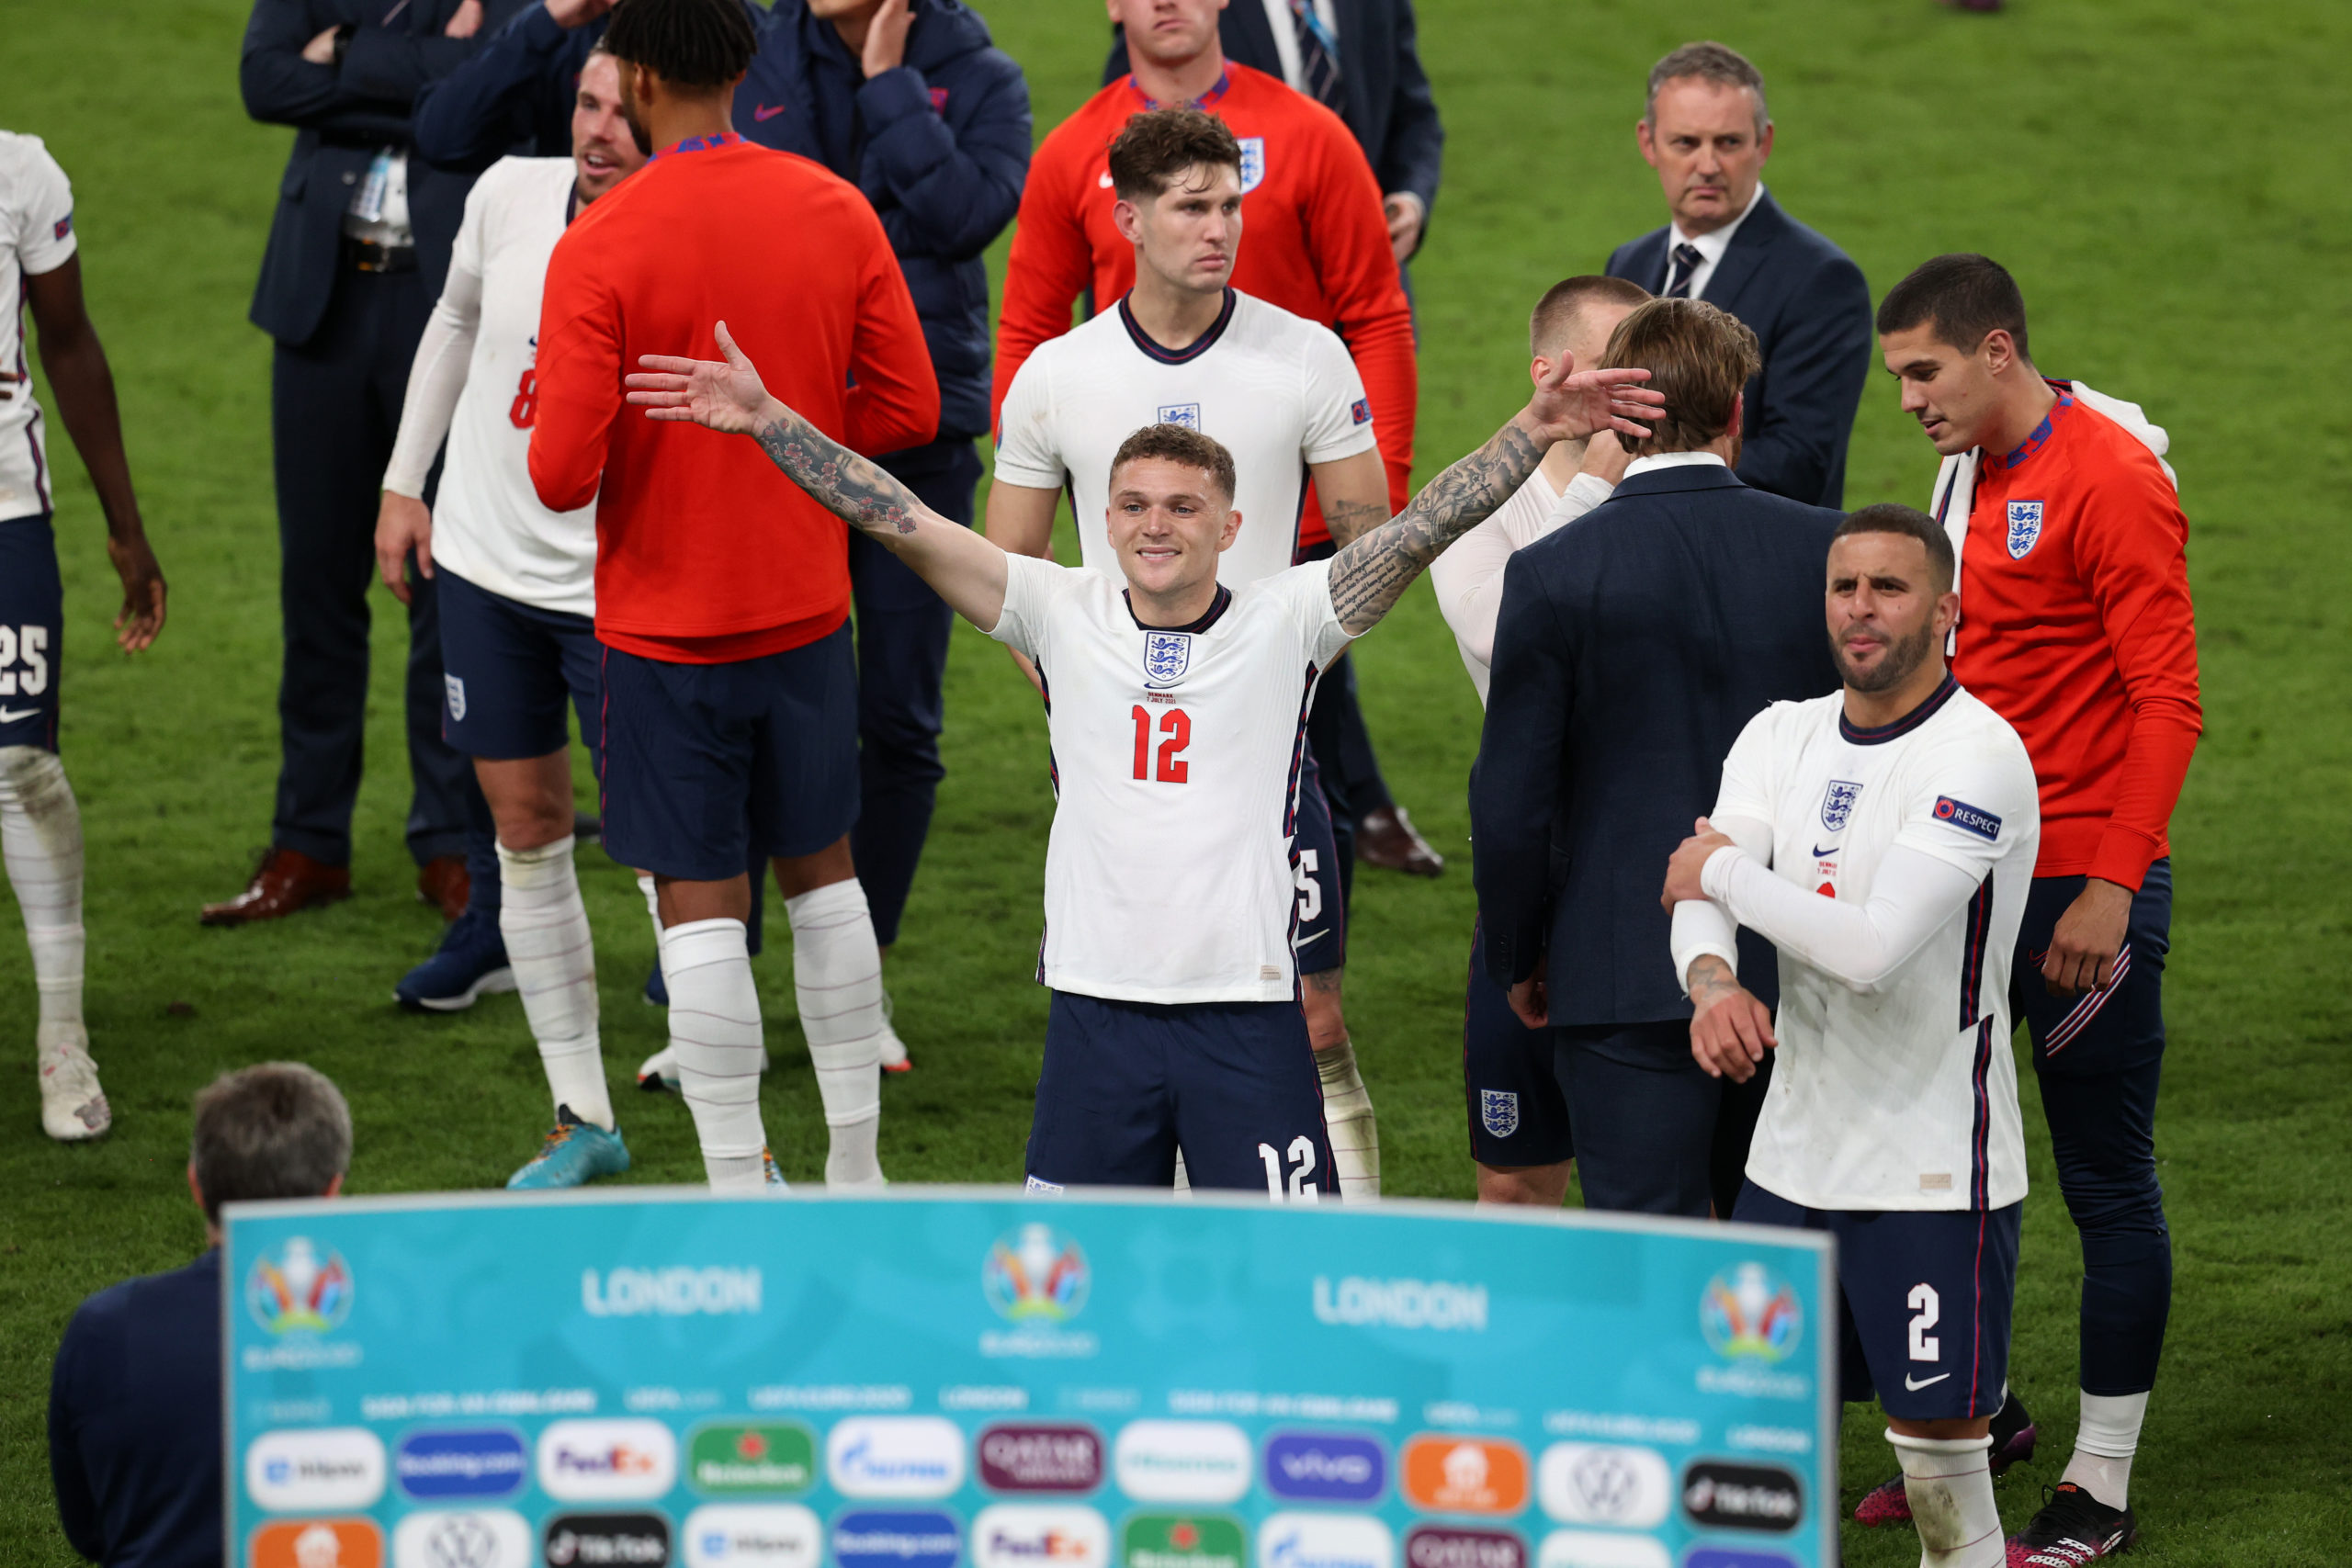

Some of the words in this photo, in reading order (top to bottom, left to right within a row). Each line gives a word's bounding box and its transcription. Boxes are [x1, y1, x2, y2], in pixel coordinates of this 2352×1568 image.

[509, 368, 538, 429] 8
[0, 625, 47, 695] 25
[1132, 705, 1192, 784] 12
[1954, 808, 2000, 835] RESPECT
[1258, 1135, 1318, 1204] 12
[582, 1267, 762, 1315] LONDON
[1312, 1276, 1487, 1330] LONDON
[1907, 1282, 1939, 1361] 2
